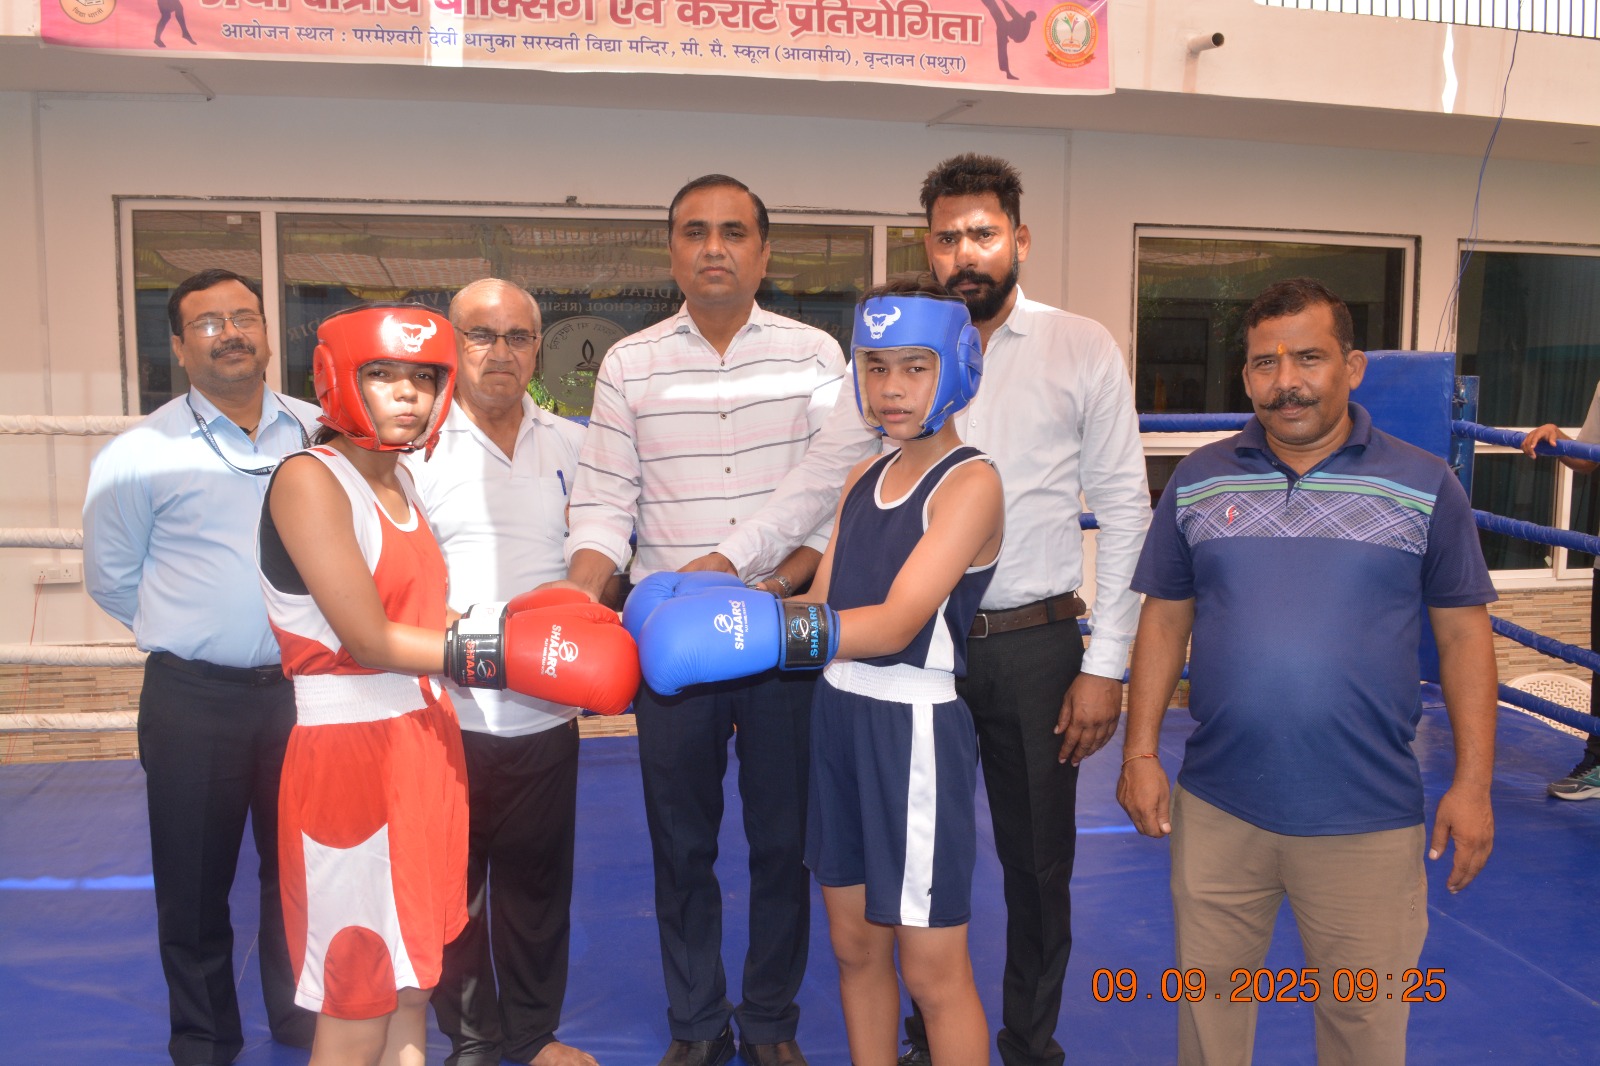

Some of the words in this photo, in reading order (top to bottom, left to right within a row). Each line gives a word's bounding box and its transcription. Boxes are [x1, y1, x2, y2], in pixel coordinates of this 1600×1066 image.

[786, 0, 982, 42] प्रतियोगिता
[222, 20, 290, 41] आयोजन
[296, 26, 334, 42] स्थल
[352, 24, 422, 45] परमेश्वरी
[427, 26, 457, 47] देवी
[465, 34, 516, 53] धानुका
[521, 33, 580, 51] सरस्वती
[586, 34, 622, 53] विद्या
[732, 45, 770, 63] स्कूल
[863, 52, 915, 70] वृन्दावन
[920, 55, 967, 75] (मथुरा)
